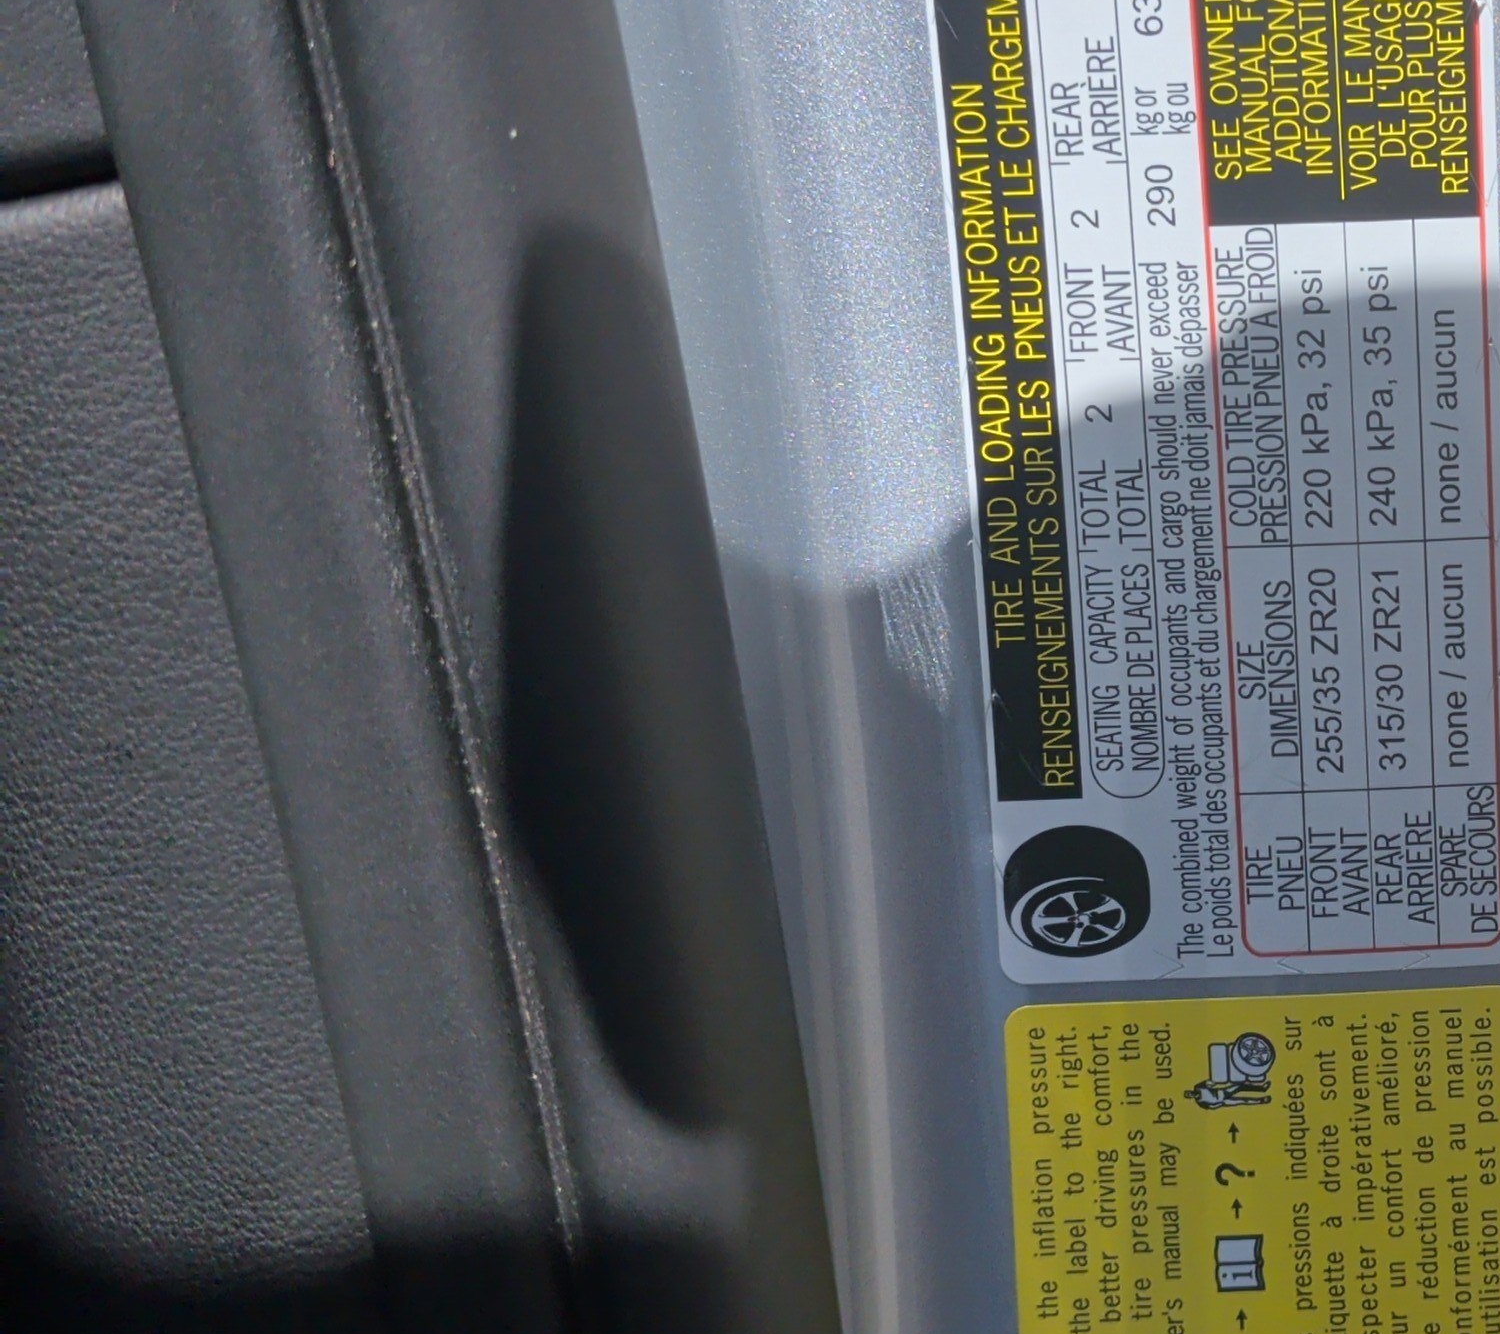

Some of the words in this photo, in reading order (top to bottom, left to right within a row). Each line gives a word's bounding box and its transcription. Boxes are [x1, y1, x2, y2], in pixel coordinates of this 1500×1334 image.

[1402, 0, 1435, 78] PLUS
[1049, 81, 1085, 157] REAR
[1079, 34, 1123, 157] ARRIÈRE
[1133, 85, 1158, 108] or
[1157, 109, 1197, 135] kg
[1165, 81, 1190, 107] ou
[1237, 33, 1273, 173] MANUAL
[1343, 67, 1374, 104] LE
[1128, 110, 1160, 136] kg
[1210, 117, 1243, 180] SEE
[1346, 123, 1377, 191] VOIR
[1377, 117, 1407, 158] DE
[1406, 88, 1438, 169] POUR
[949, 83, 1003, 319] INFORMATION
[998, 158, 1034, 196] LE
[1142, 163, 1176, 227] 290
[1002, 205, 1038, 245] ET
[1069, 208, 1100, 229] 2
[1131, 257, 1171, 341] exceed
[1243, 225, 1277, 304] FROID
[1292, 268, 1331, 315] psi
[1358, 265, 1397, 312] psi
[1006, 254, 1047, 360] PNEUS
[1062, 261, 1099, 353] FRONT
[1100, 263, 1136, 353] AVANT
[1213, 244, 1251, 386] PRESSURE
[1137, 345, 1175, 408] never
[1249, 334, 1283, 407] PNEU
[1295, 328, 1326, 369] 32
[1361, 325, 1392, 366] 35
[1433, 308, 1458, 411] aucun
[971, 333, 1015, 482] LOADING
[1016, 379, 1052, 437] LES
[1083, 403, 1113, 423] 2
[1221, 392, 1254, 450] TIRE
[1299, 381, 1332, 454] kPa,
[1364, 378, 1398, 451] kPa,
[1022, 446, 1057, 506] SUR
[1141, 412, 1180, 484] should
[1253, 413, 1289, 544] PRESSION
[1437, 441, 1461, 524] none
[1076, 458, 1111, 546] TOTAL
[1113, 457, 1147, 545] TOTAL
[1146, 488, 1187, 552] cargo
[1225, 455, 1258, 527] COLD
[1301, 467, 1333, 529] 220
[1366, 465, 1397, 526] 240
[985, 496, 1020, 564] AND
[991, 578, 1025, 648] TIRE
[1119, 562, 1154, 645] PLACES
[1150, 555, 1187, 598] and
[1306, 567, 1339, 655] ZR20
[1370, 569, 1402, 653] ZR21
[1441, 563, 1466, 660] aucun
[1083, 563, 1119, 665] CAPACITY
[1027, 516, 1075, 787] RENSEIGNEMENTS
[1124, 649, 1155, 678] DE
[1160, 603, 1195, 707] occupants
[1235, 639, 1267, 701] SIZE
[1261, 579, 1300, 758] DIMENSIONS
[1090, 684, 1125, 772] SEATING
[1126, 682, 1165, 774] NOMBRE
[1160, 712, 1194, 739] of
[1311, 665, 1344, 774] 255/35
[1373, 663, 1407, 771] 315/30
[1445, 690, 1469, 768] none
[1166, 743, 1202, 810] weight
[1169, 817, 1203, 914] combined
[1243, 844, 1274, 905] TIRE
[1274, 835, 1306, 911] PNEU
[1307, 825, 1339, 918] FRONT
[1338, 826, 1371, 916] AVANT
[1372, 832, 1404, 905] REAR
[1395, 809, 1436, 925] ARRIÈRE
[1437, 822, 1469, 897] SPARE
[1465, 784, 1498, 896] SECOURS
[1175, 922, 1205, 960] The
[1469, 900, 1499, 934] DE
[1148, 1021, 1173, 1079] used.
[1283, 1015, 1303, 1051] sur
[1311, 1014, 1335, 1028] à
[1438, 1007, 1465, 1099] manuel
[1027, 1026, 1055, 1135] pressure
[1086, 1024, 1113, 1126] comfort,
[1313, 1048, 1338, 1101] sont
[1373, 1011, 1401, 1126] amélioré,
[1406, 1009, 1437, 1113] pression
[1468, 1007, 1499, 1124] possible.
[1151, 1097, 1175, 1125] be
[1281, 1072, 1310, 1180] indiquées
[1448, 1122, 1467, 1151] au
[1158, 1141, 1181, 1187] may
[1316, 1123, 1341, 1193] droite
[1410, 1134, 1435, 1164] de
[1473, 1145, 1497, 1185] est
[1029, 1157, 1056, 1257] inflation
[1092, 1148, 1119, 1229] driving
[1319, 1214, 1343, 1229] à
[1379, 1147, 1405, 1238] confort
[1155, 1204, 1182, 1280] manual
[1287, 1201, 1318, 1311] pressions
[1388, 1260, 1407, 1288] un
[1413, 1186, 1439, 1300] réduction
[1035, 1280, 1060, 1320] the
[1097, 1250, 1122, 1323] better
